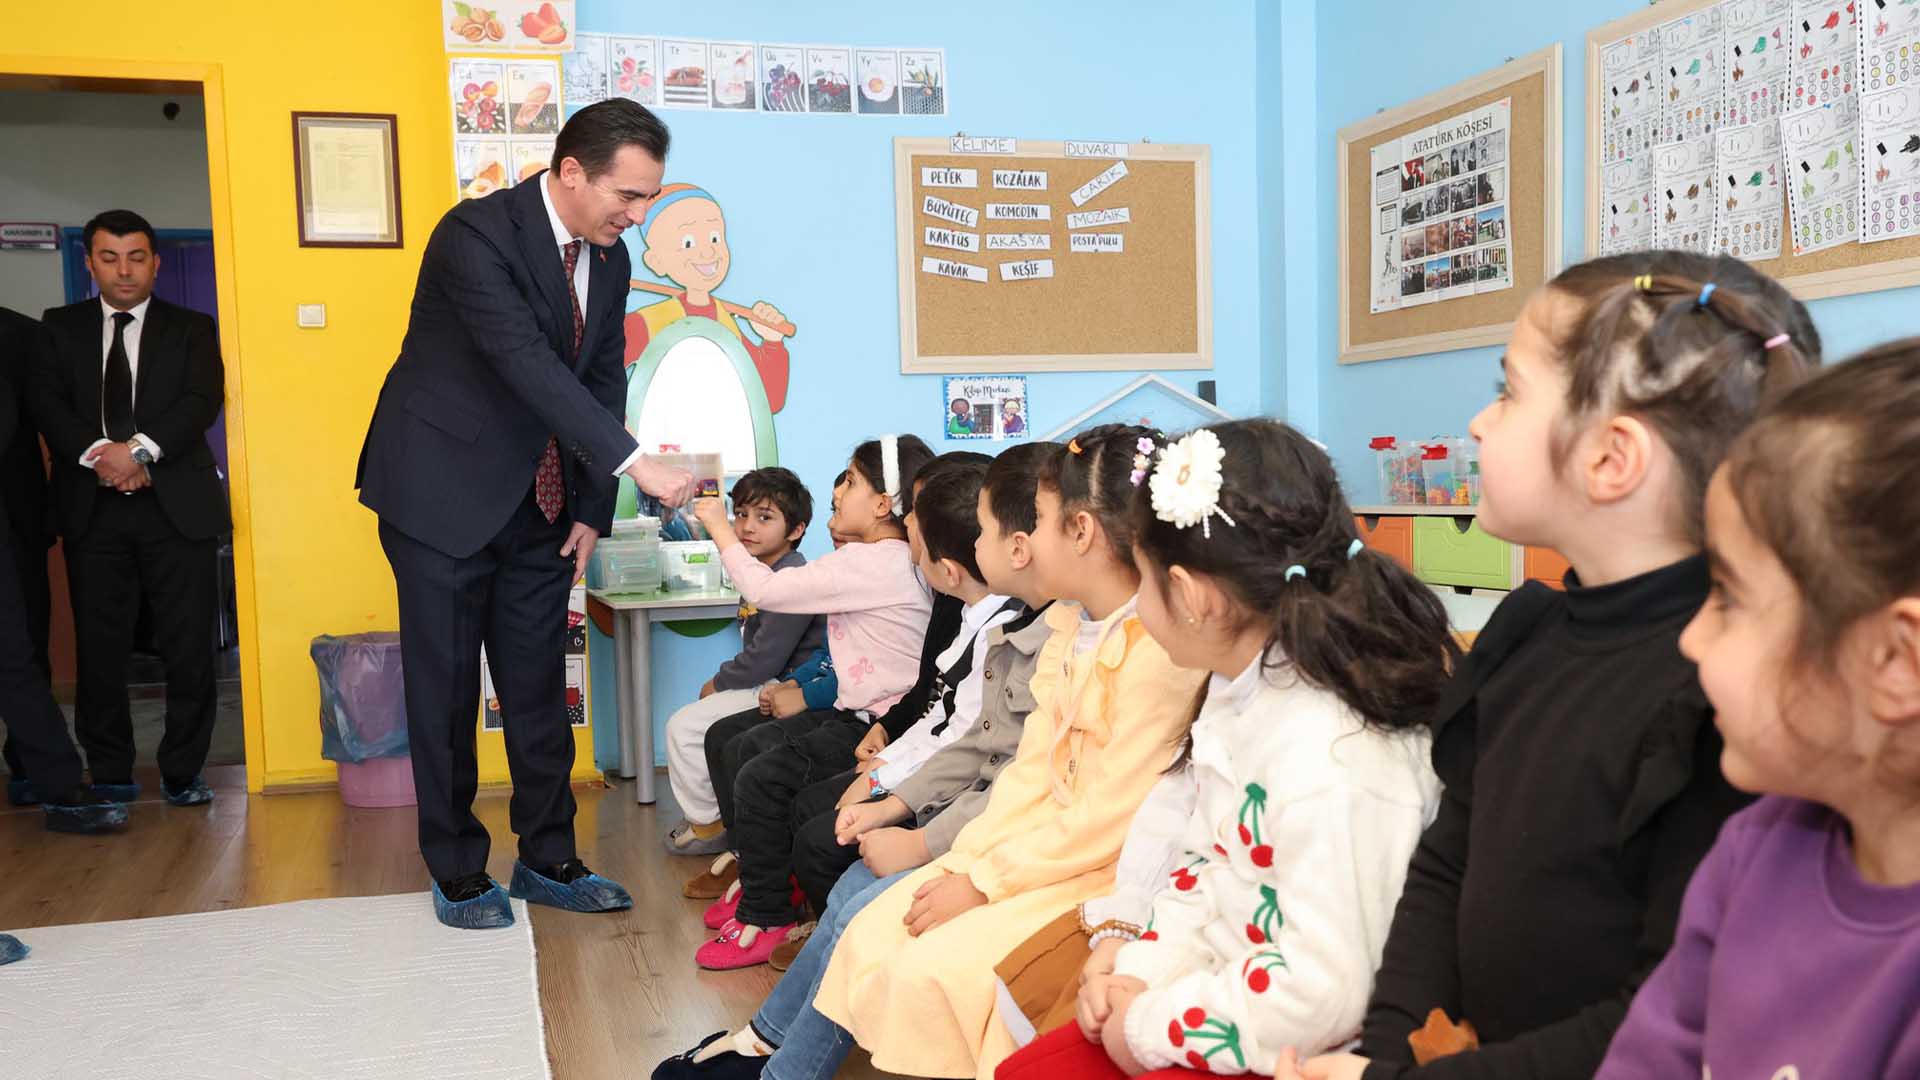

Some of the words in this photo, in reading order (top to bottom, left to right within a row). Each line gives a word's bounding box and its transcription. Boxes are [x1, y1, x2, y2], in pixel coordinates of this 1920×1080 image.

[1411, 131, 1454, 155] ATATÜRK
[1456, 112, 1493, 140] KÖŞESİ
[931, 171, 962, 184] PETEK
[996, 173, 1041, 187] KOZALAK
[990, 236, 1045, 248] AKASYA
[1072, 235, 1096, 246] POSTA
[1098, 236, 1118, 246] PULU
[938, 262, 969, 277] KAVAK
